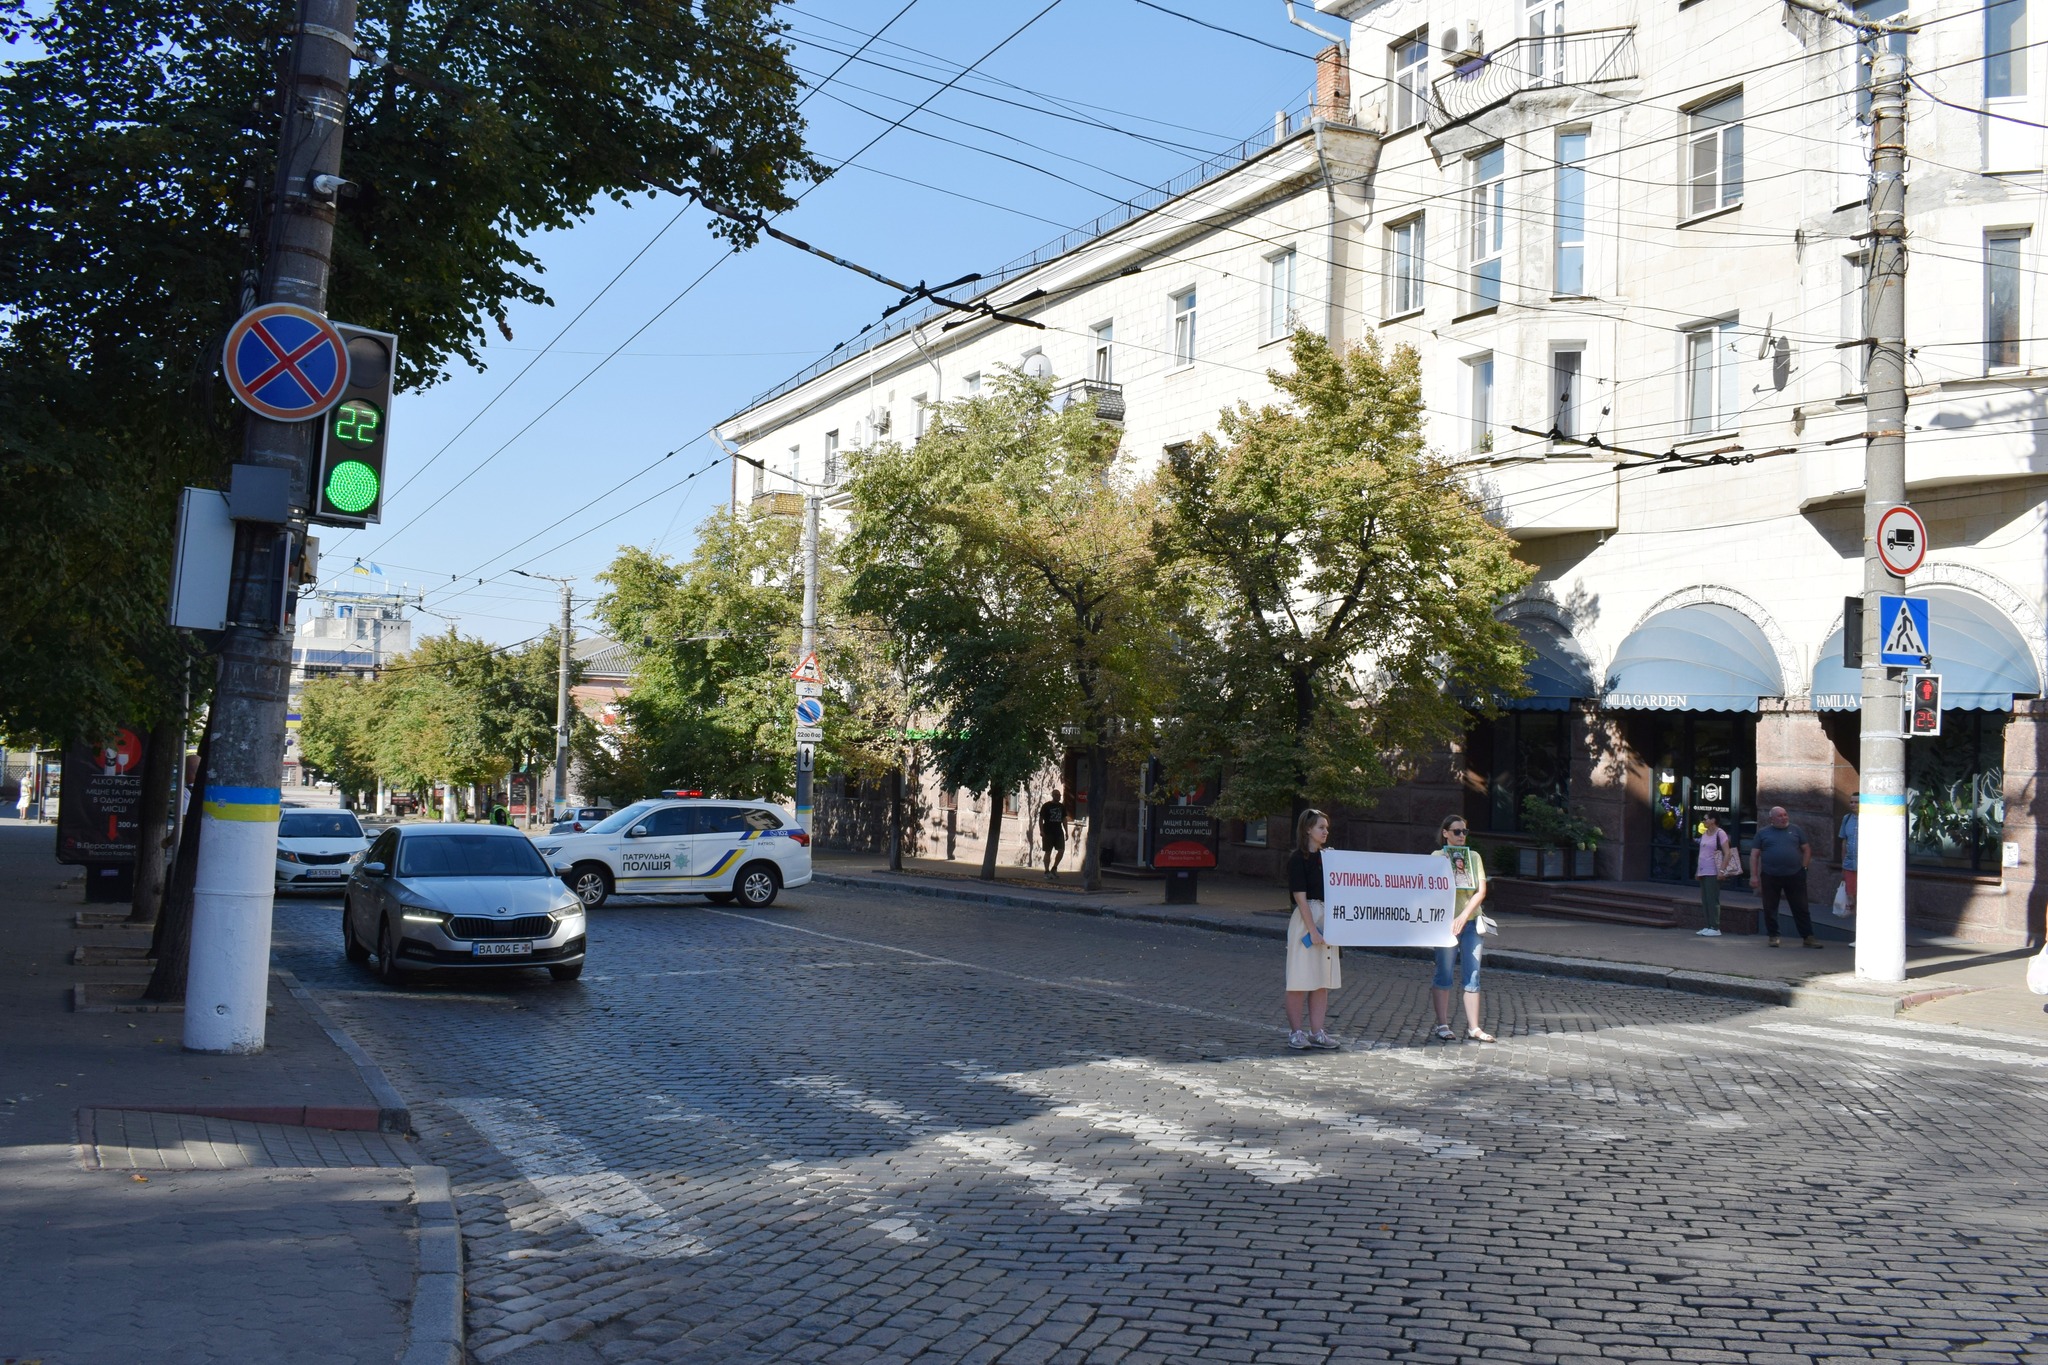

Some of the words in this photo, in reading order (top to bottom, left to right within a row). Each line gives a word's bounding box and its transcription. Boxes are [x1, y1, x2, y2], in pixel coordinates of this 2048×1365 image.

[336, 406, 376, 442] 22
[1633, 694, 1687, 707] GARDEN
[1816, 694, 1857, 708] FAMILIA
[1916, 711, 1936, 728] 25
[91, 778, 113, 786] ALKO
[114, 779, 141, 787] PLACE
[1168, 808, 1185, 816] ALKO
[622, 853, 671, 861] ПАТРУЛЬНА
[623, 861, 671, 872] ПОЛІЦІЯ
[1329, 872, 1383, 888] ЗУПИНИСЬ.
[1384, 873, 1427, 890] ВШАНУЙ.
[1428, 876, 1449, 891] 9:00
[1333, 905, 1446, 923] #Я_ЗУПИНЯЮСЬ_А_ТИ?
[479, 944, 492, 954] BA
[495, 944, 511, 954] 004
